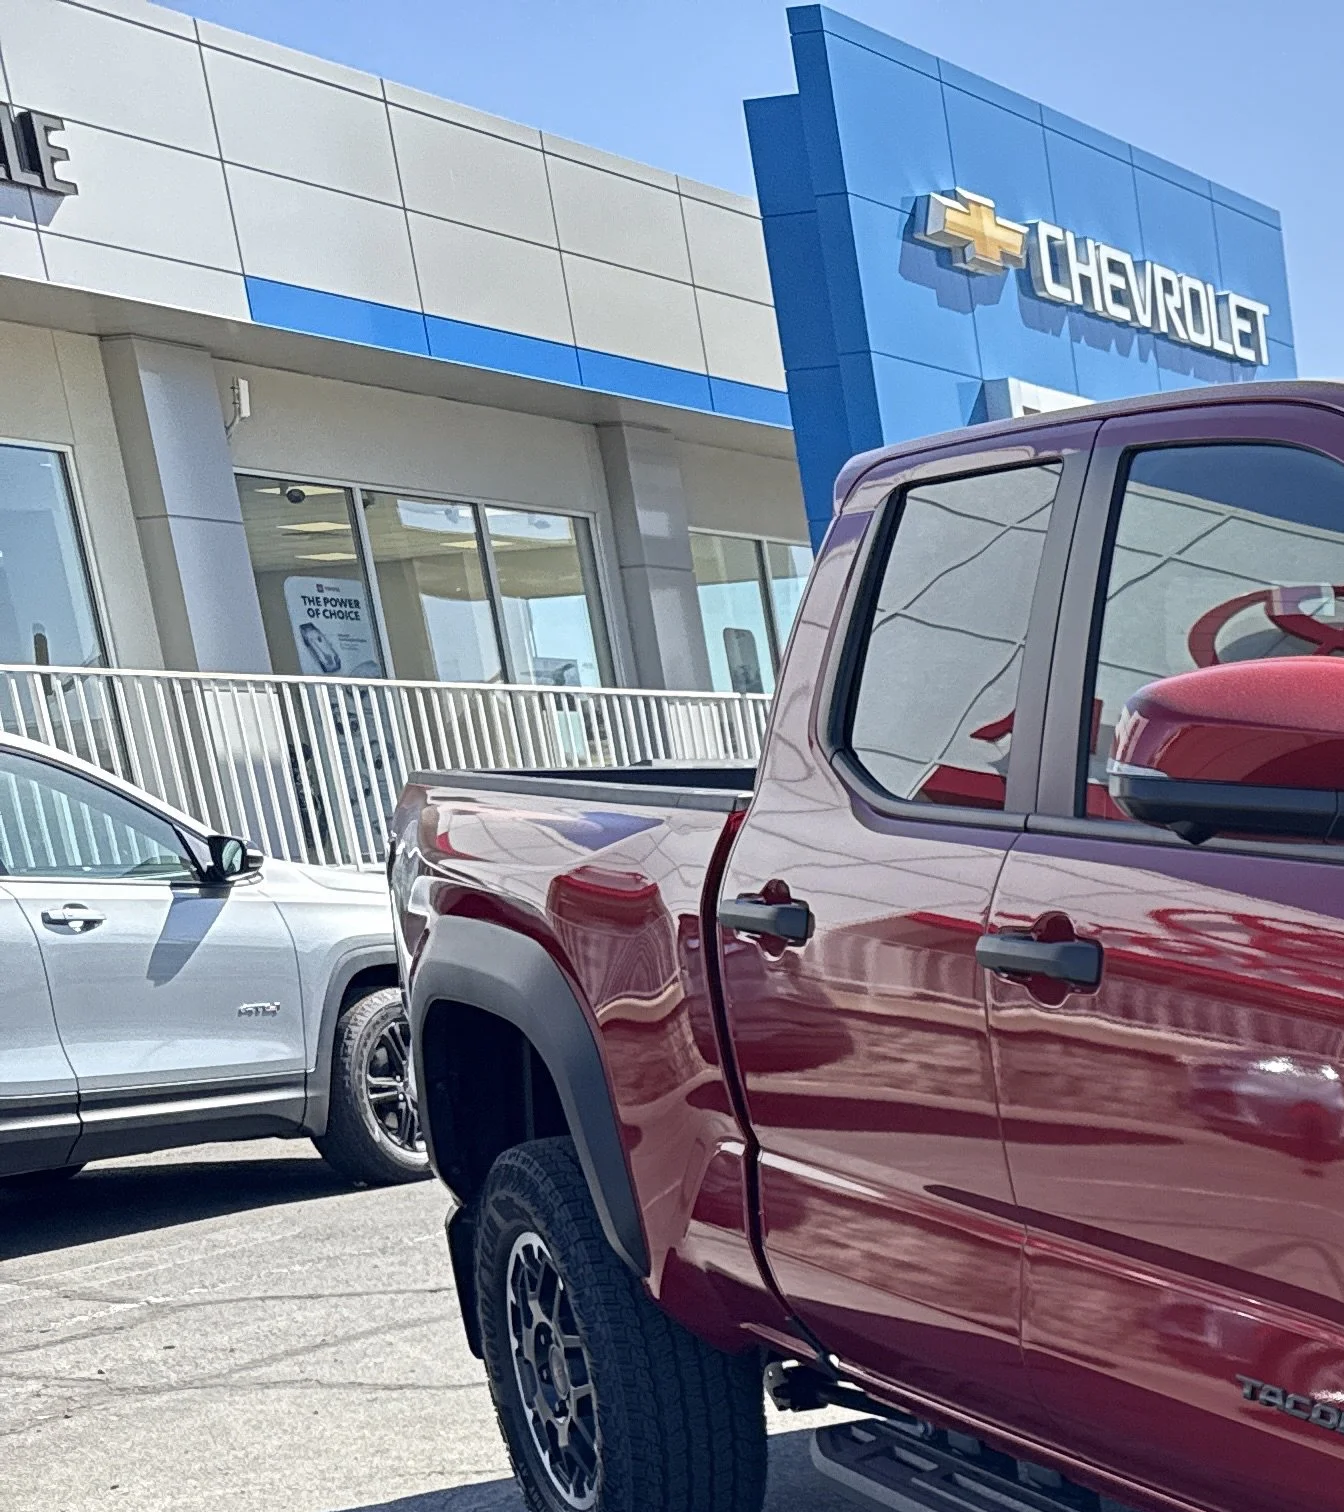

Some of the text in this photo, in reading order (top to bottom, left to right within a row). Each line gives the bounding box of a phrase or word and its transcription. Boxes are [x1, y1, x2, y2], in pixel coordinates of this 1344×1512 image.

[1034, 220, 1270, 367] CHEVROLET
[301, 595, 361, 609] THE POWER
[307, 607, 361, 621] OF CHOICE
